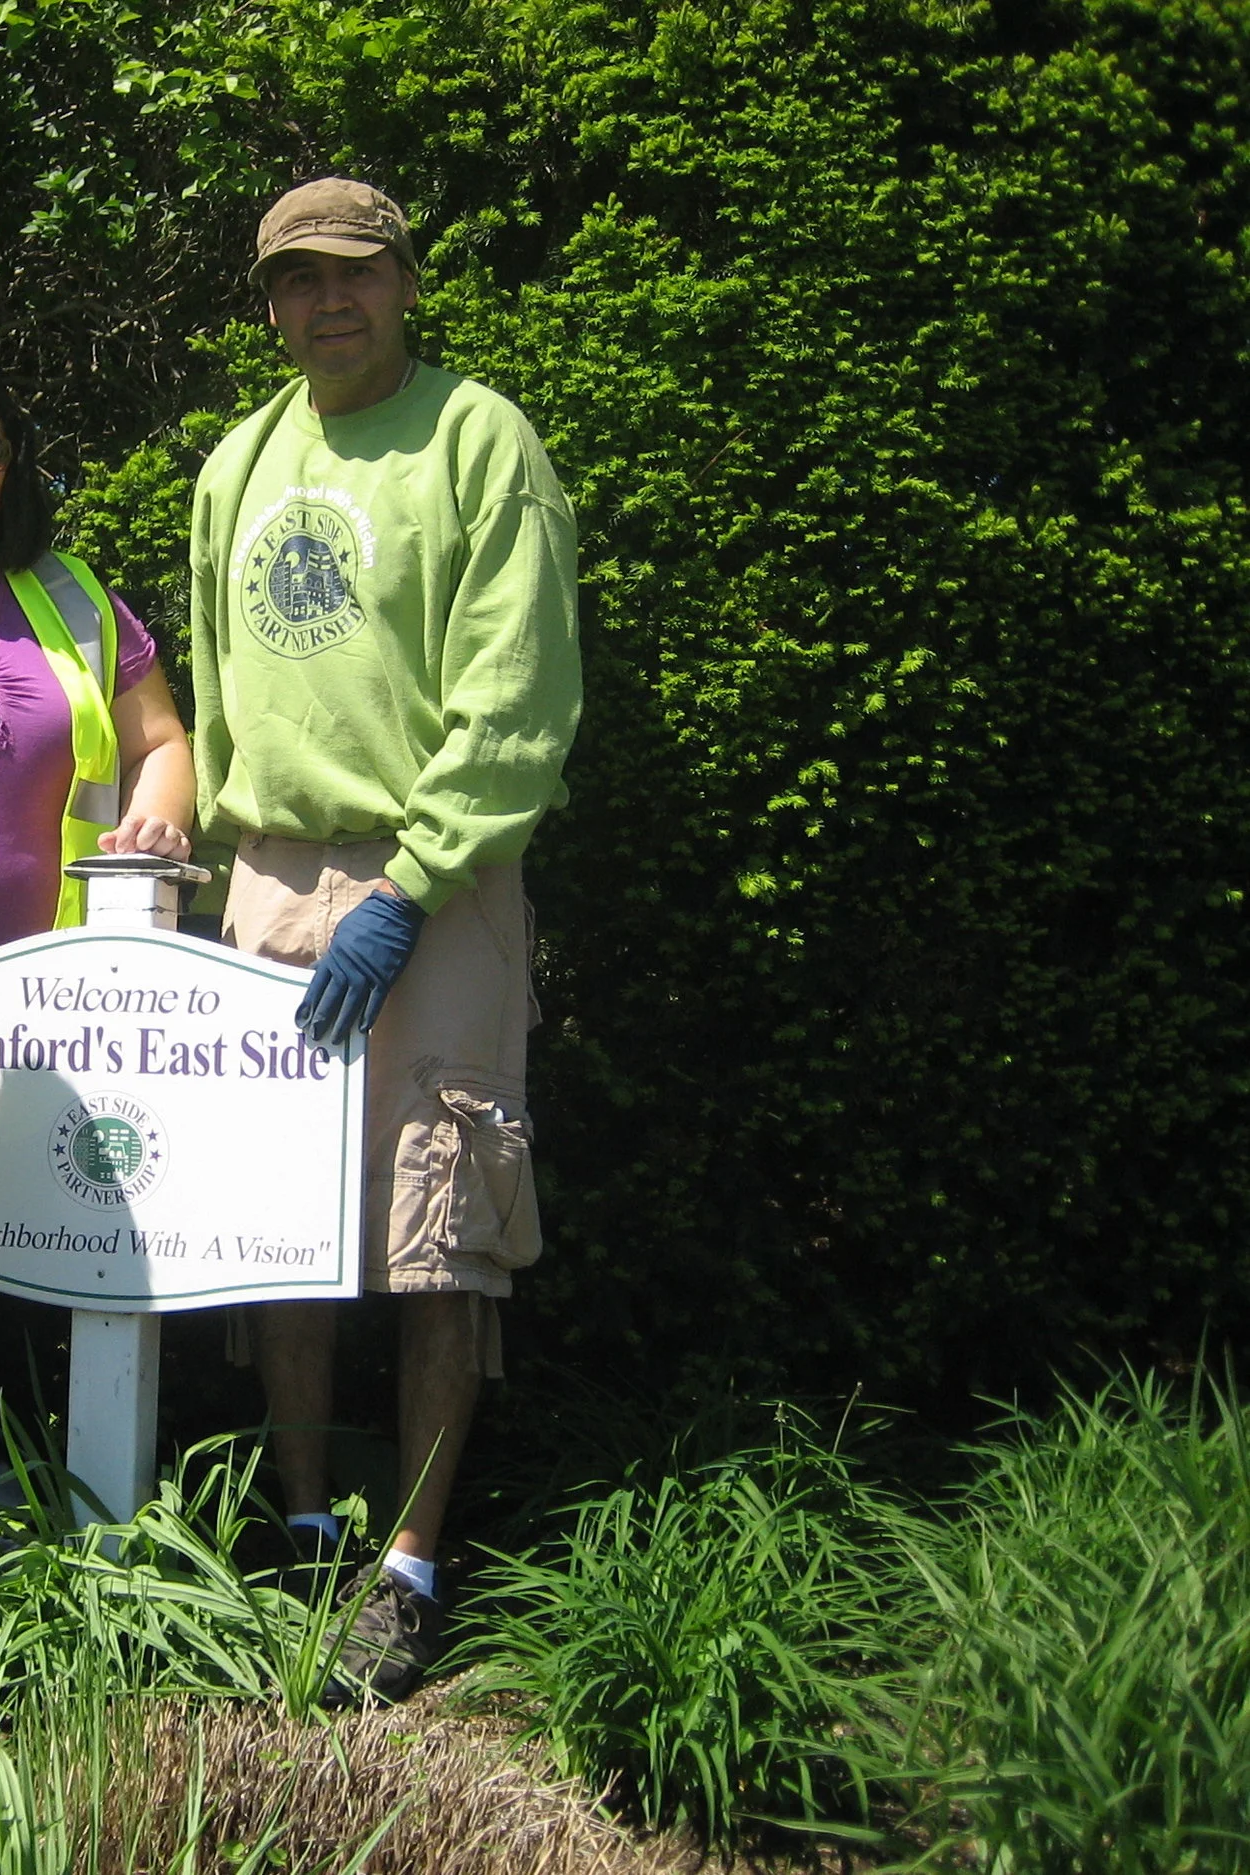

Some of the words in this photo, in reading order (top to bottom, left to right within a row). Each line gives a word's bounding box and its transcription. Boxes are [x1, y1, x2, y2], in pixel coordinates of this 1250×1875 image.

[314, 513, 344, 547] SIDE
[19, 976, 179, 1014] Welcome
[187, 984, 221, 1015] to
[135, 1027, 229, 1077] East
[239, 1029, 331, 1081] Side
[66, 1096, 109, 1126] EAST
[111, 1098, 150, 1129] SIDE
[56, 1161, 156, 1206] PARTNERSHIP
[129, 1229, 187, 1259] With
[201, 1235, 225, 1261] A
[235, 1235, 332, 1267] Vision"
